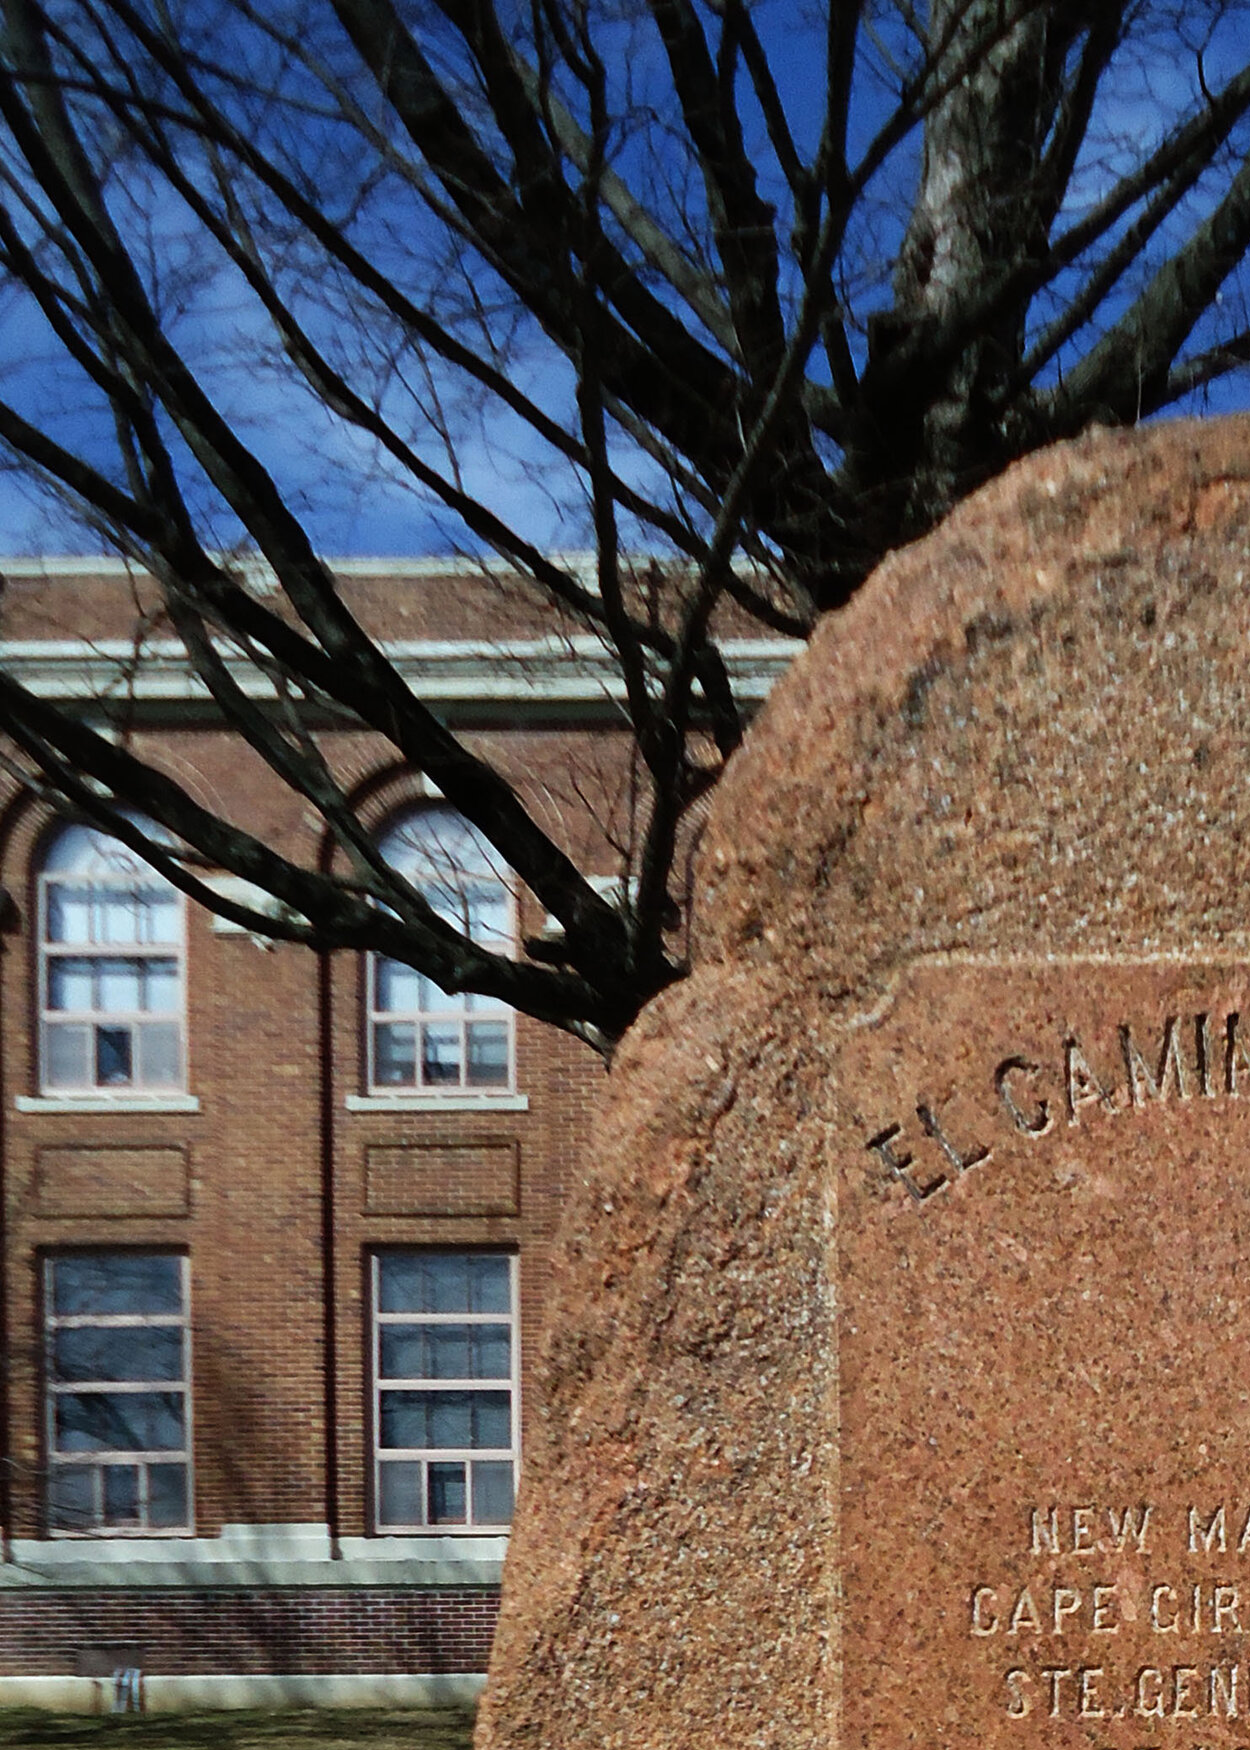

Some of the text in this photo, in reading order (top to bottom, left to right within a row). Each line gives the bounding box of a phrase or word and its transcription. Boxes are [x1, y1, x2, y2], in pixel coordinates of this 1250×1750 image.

[865, 1103, 990, 1201] EL
[1029, 1506, 1153, 1554] NEW
[970, 1586, 1119, 1637] CAPE
